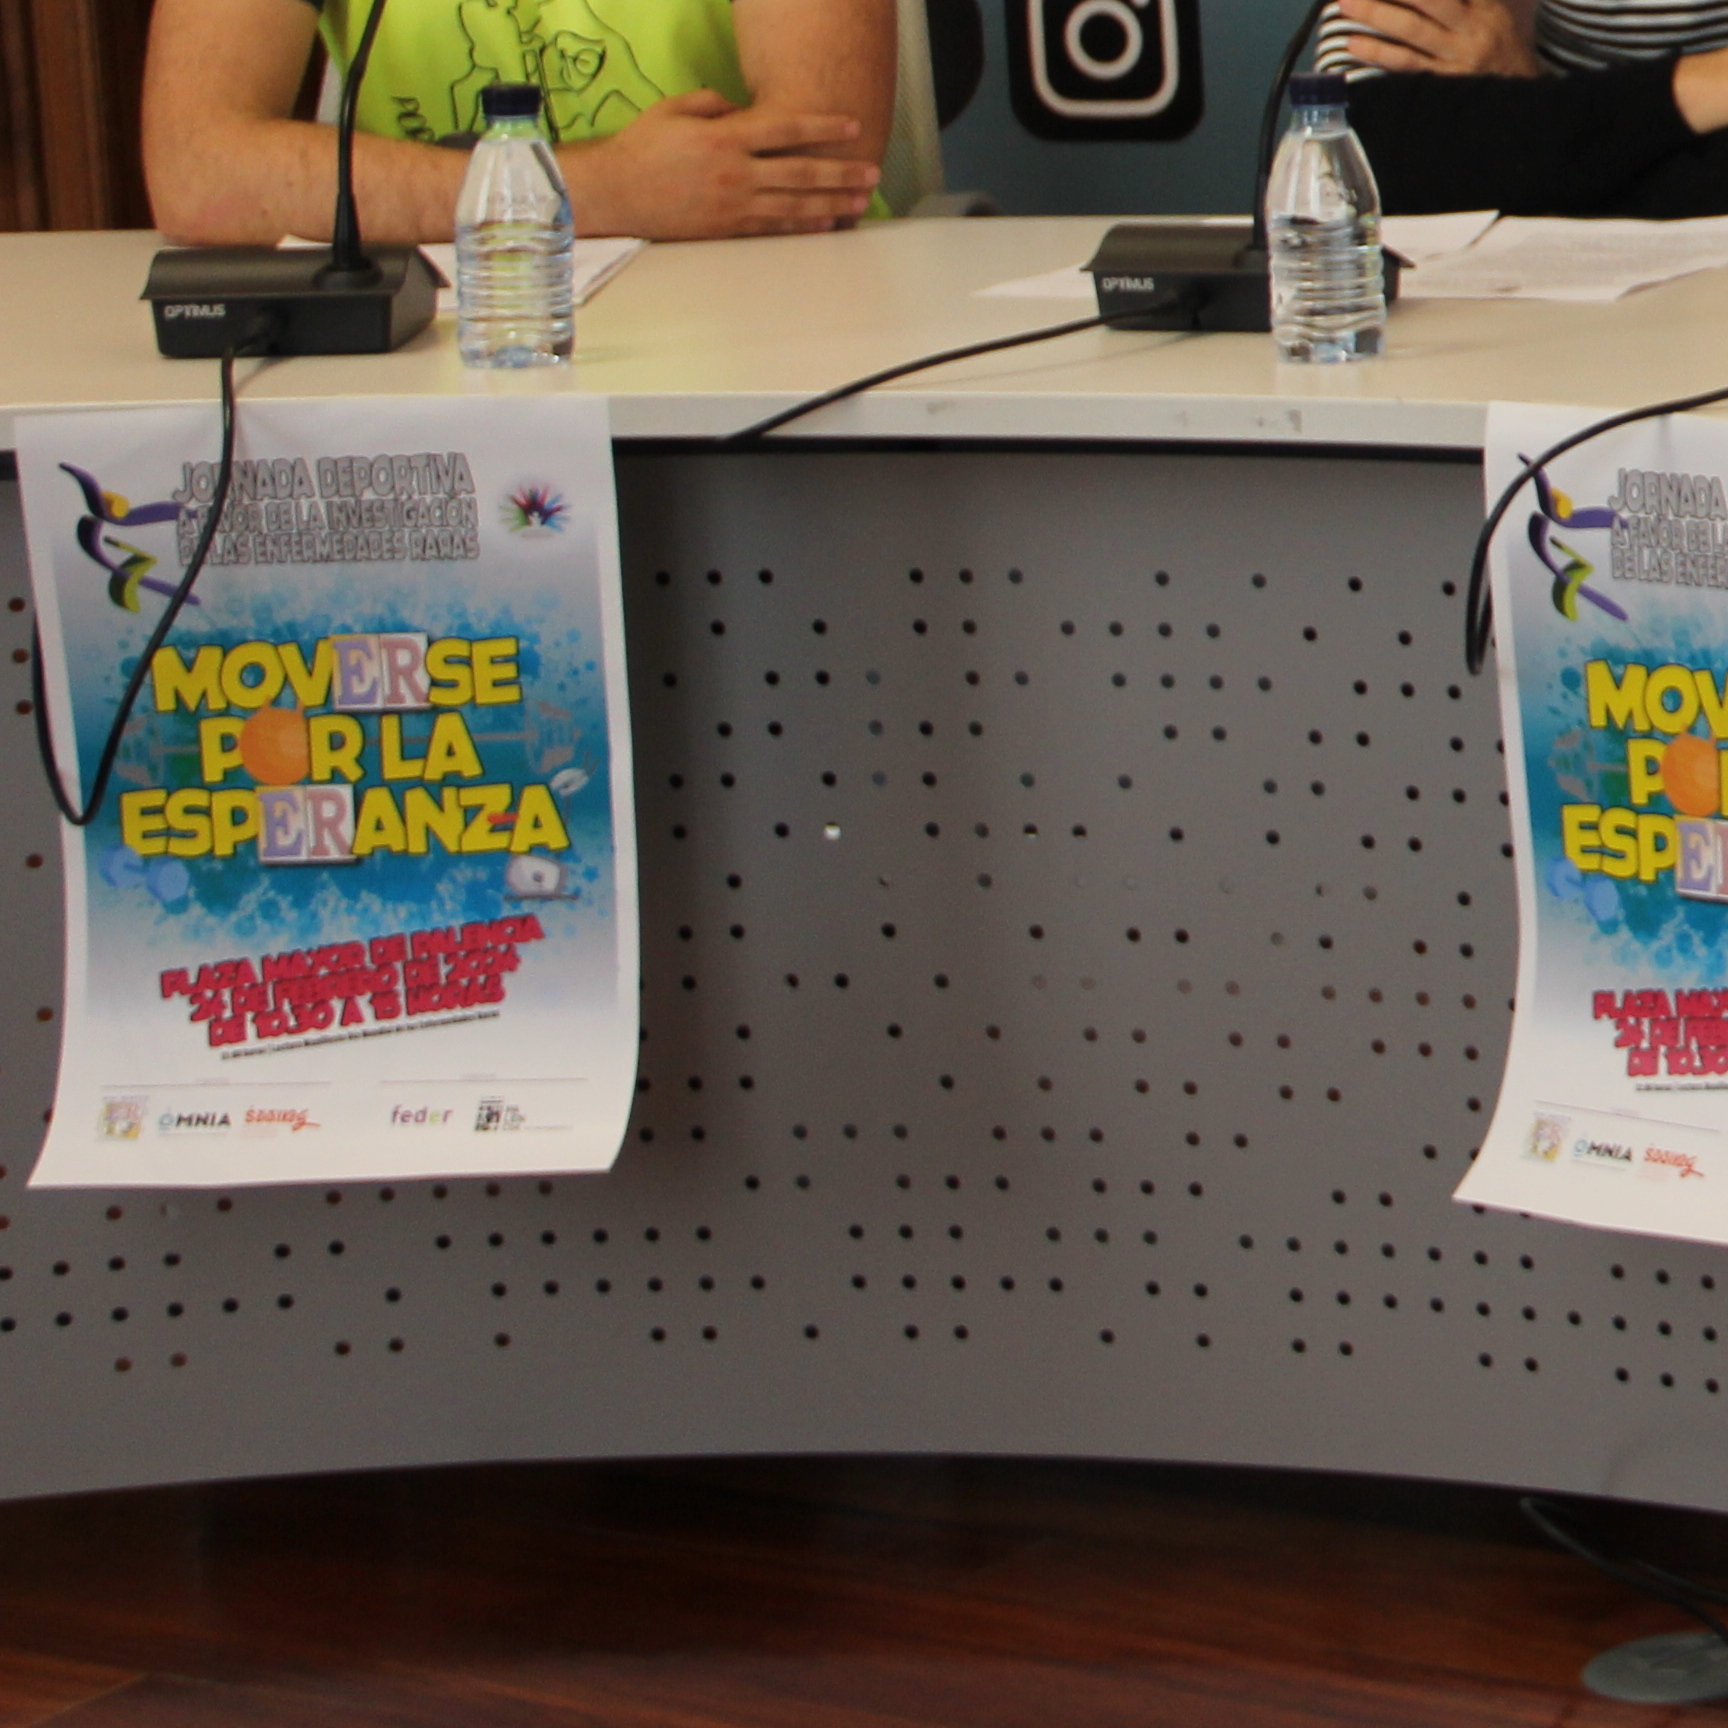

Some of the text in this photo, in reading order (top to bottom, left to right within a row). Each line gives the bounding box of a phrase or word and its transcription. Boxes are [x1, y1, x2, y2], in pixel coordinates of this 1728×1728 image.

[1608, 468, 1728, 521] JORNADA
[151, 633, 523, 713] MOVERSE
[379, 710, 485, 783] LA
[119, 783, 571, 865] ESPERANZA
[391, 1103, 453, 1125] feder
